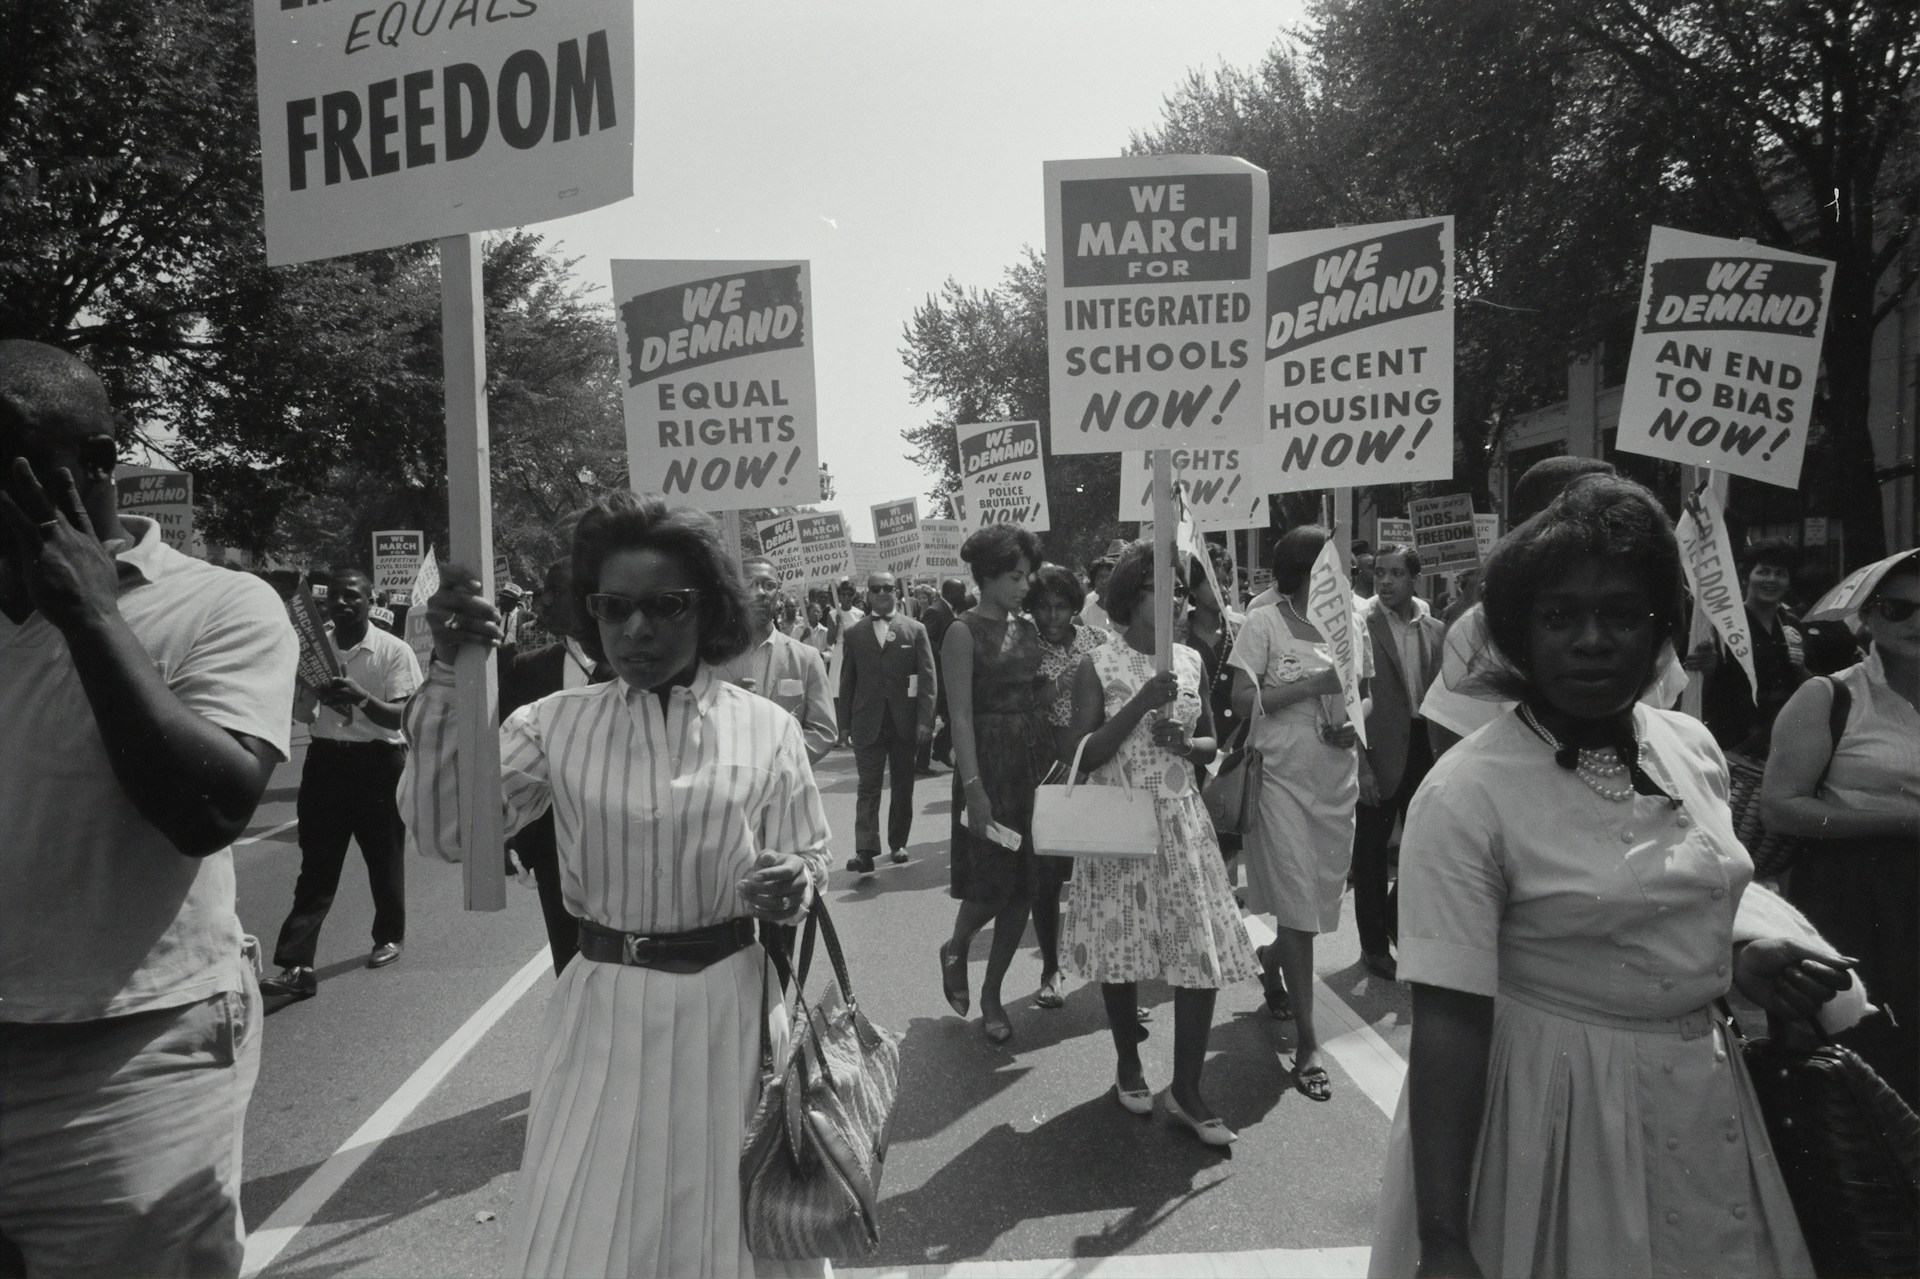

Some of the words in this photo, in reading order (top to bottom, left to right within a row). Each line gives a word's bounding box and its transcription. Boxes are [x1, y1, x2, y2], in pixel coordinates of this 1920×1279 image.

[286, 29, 617, 191] FREEDOM
[1129, 184, 1185, 213] WE
[1077, 216, 1238, 257] MARCH
[1128, 260, 1190, 278] FOR
[1313, 242, 1382, 294] WE
[1706, 261, 1773, 291] WE
[682, 279, 746, 322] WE
[1266, 266, 1438, 349] DEMAND
[1655, 293, 1815, 326] DEMAND
[1064, 292, 1251, 331] INTEGRATED
[640, 305, 798, 373] DEMAND
[1065, 339, 1249, 377] SCHOOLS
[1283, 346, 1428, 388] DECENT
[1655, 340, 1713, 372] AN
[1724, 351, 1802, 391] END
[658, 379, 789, 411] EQUAL
[1080, 378, 1241, 433] NOW!
[1655, 372, 1702, 403] TO
[1712, 383, 1796, 424] BIAS
[1269, 388, 1442, 430] HOUSING
[658, 415, 795, 448] RIGHTS
[986, 428, 1013, 449] WE
[1649, 407, 1791, 462] NOW!
[968, 439, 1035, 473] DEMAND
[1281, 418, 1433, 473] NOW!
[662, 445, 801, 495] NOW!
[1143, 450, 1239, 470] RGHTS
[139, 475, 167, 490] WE
[975, 473, 998, 484] AN
[1002, 471, 1032, 482] END
[122, 487, 186, 506] DEMAND
[979, 496, 1031, 509] BRUTALITY
[988, 486, 1024, 498] POLICE
[889, 507, 901, 516] WE
[980, 502, 1041, 526] NOW!
[1415, 503, 1440, 513] UAW
[1442, 499, 1464, 509] SAYS
[774, 520, 791, 535] WE
[812, 517, 827, 526] WE
[880, 513, 913, 529] MARCH
[1415, 510, 1453, 528] JOBS
[1454, 512, 1470, 521] and
[766, 530, 796, 551] DEMA
[802, 524, 840, 537] MARCH
[879, 537, 899, 549] FIRST
[899, 532, 920, 545] CLASS
[1416, 526, 1473, 546] FREEDOM
[379, 542, 417, 551] MARCH
[770, 549, 784, 557] AN
[787, 546, 799, 554] EN
[802, 540, 847, 554] INTEGRATED
[879, 541, 921, 560] CITIZENSHIP
[804, 550, 849, 565] SCHOOLS
[811, 559, 849, 577] NOW!
[887, 553, 920, 573] NOW!
[380, 576, 418, 586] NOW!
[292, 593, 315, 635] MARCH
[1308, 562, 1351, 669] FREEDOM
[1722, 616, 1735, 630] IN
[1728, 628, 1749, 659] '63
